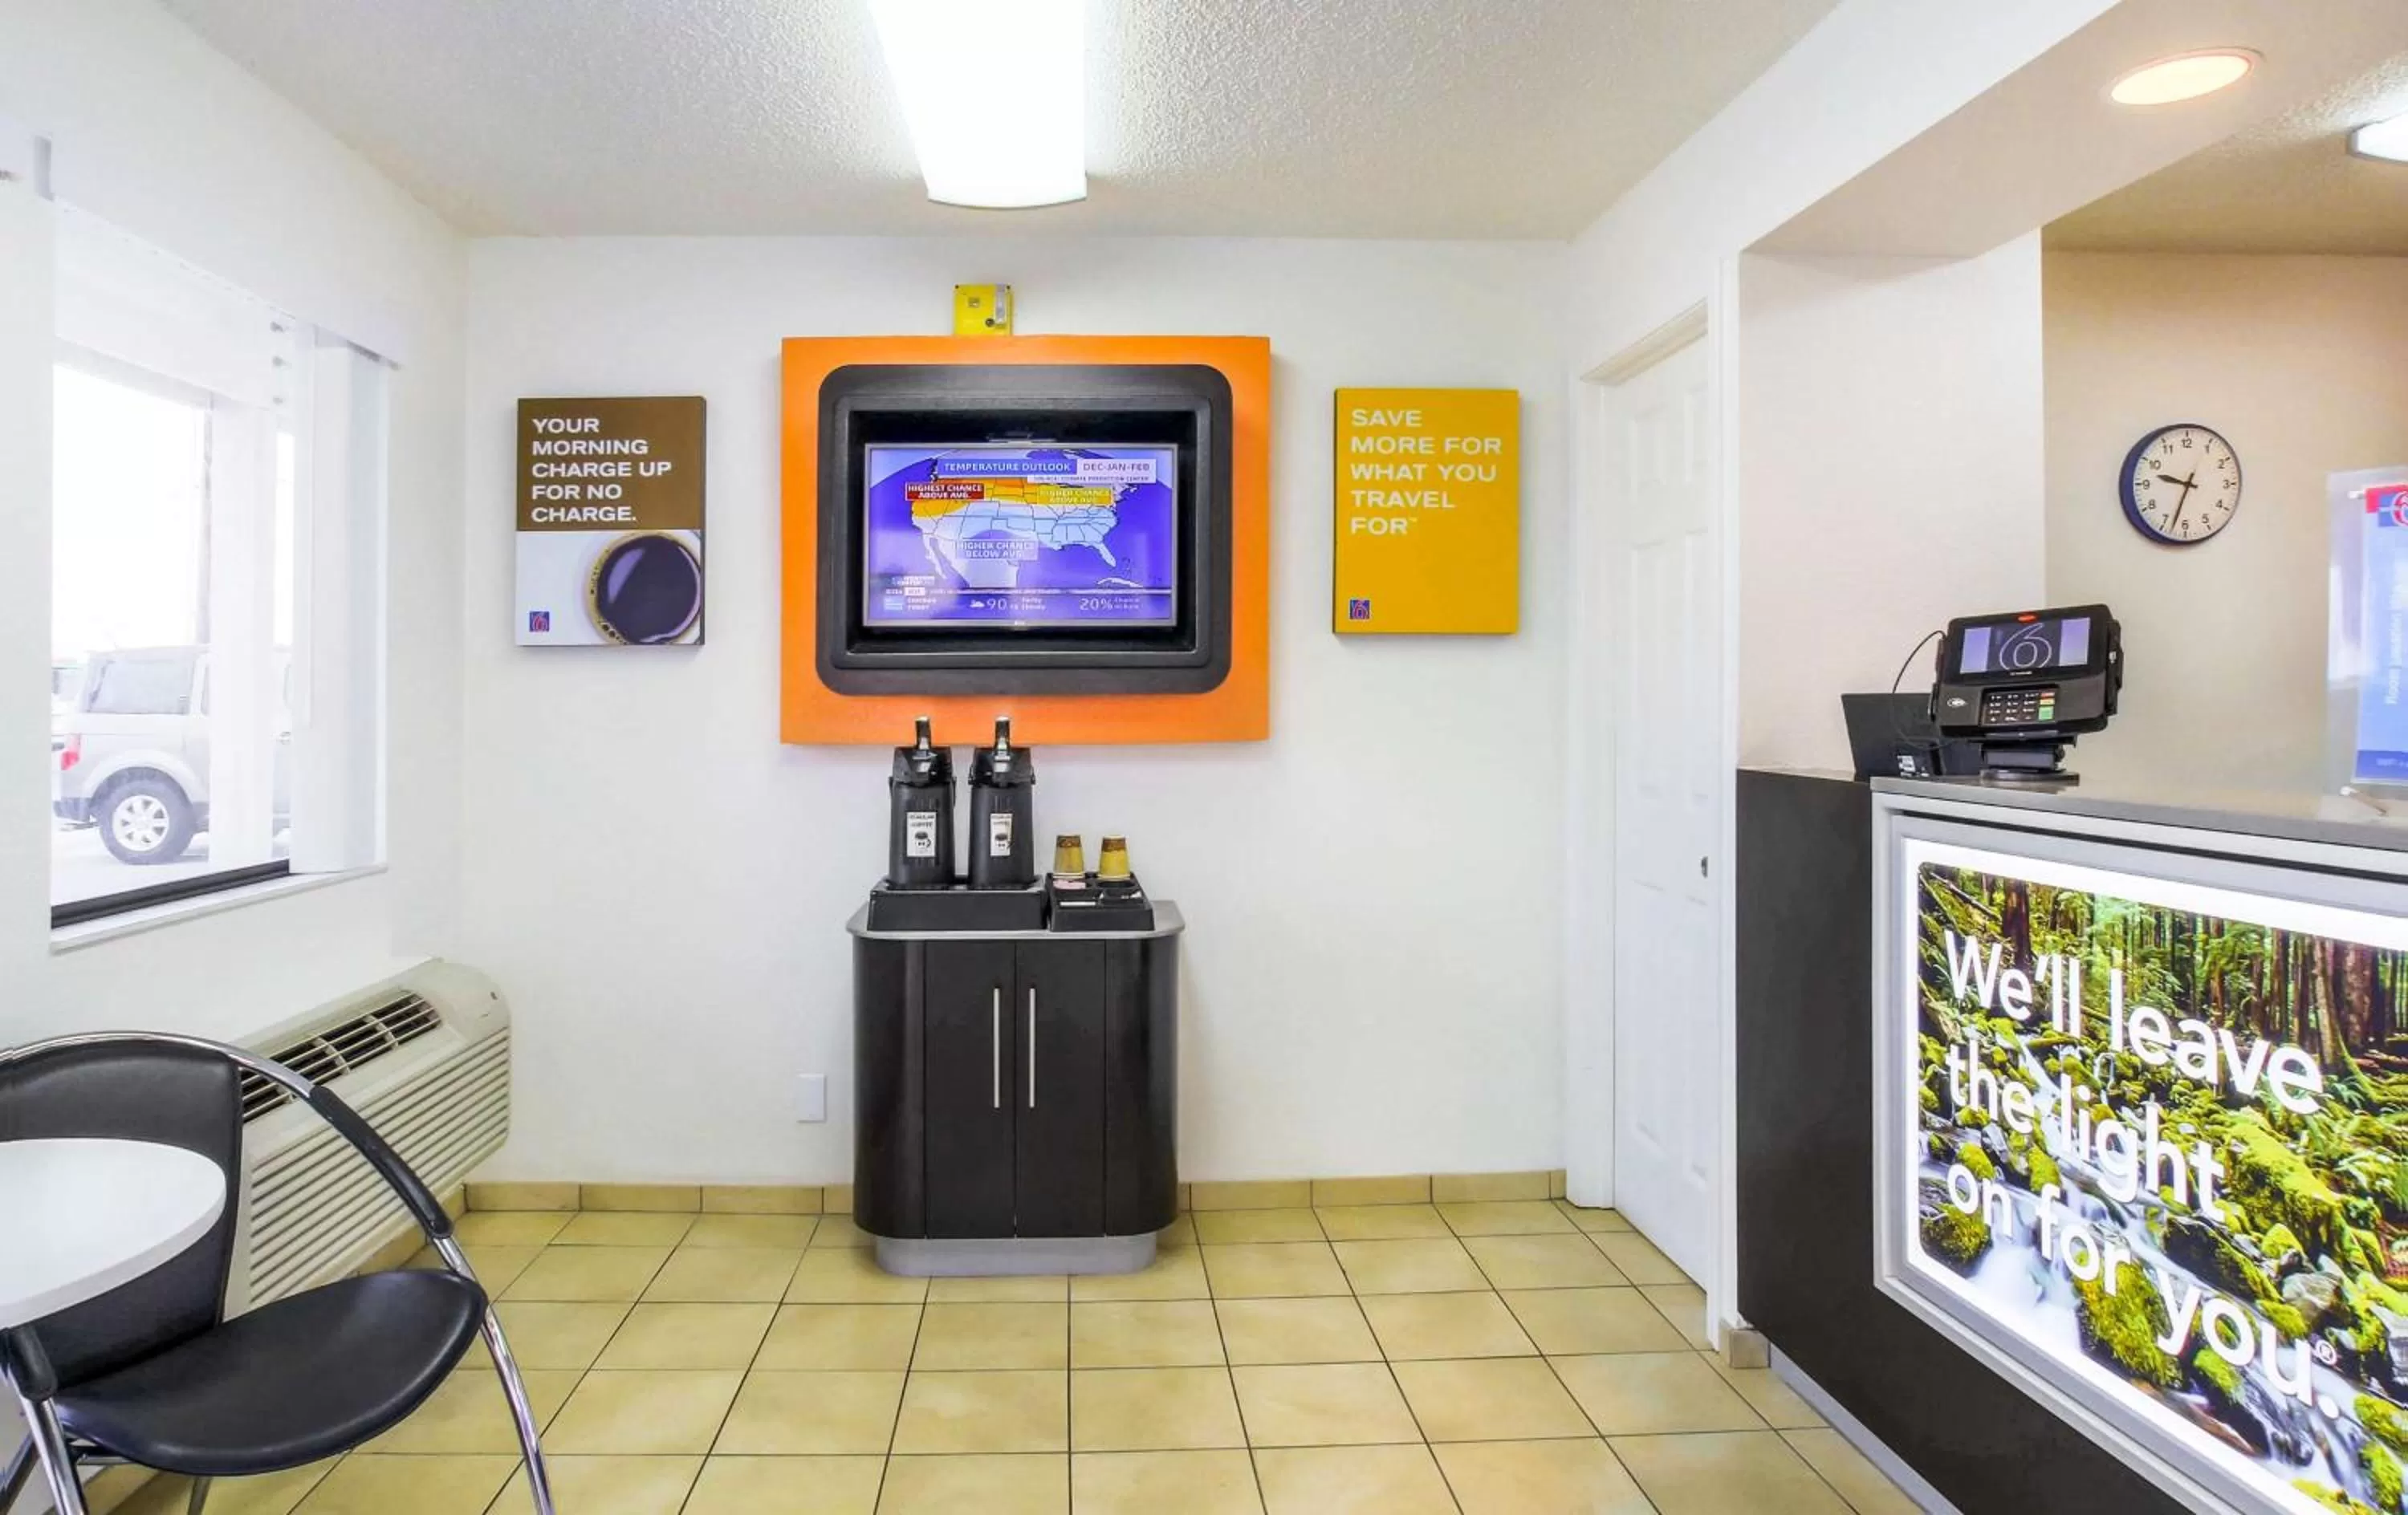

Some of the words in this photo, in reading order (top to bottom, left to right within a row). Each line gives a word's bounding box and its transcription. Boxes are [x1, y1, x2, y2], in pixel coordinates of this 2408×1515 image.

[1351, 409, 1422, 427] SAVE
[532, 418, 600, 433] YOUR
[531, 440, 649, 456] MORNING
[1350, 437, 1436, 454] MORE
[1445, 437, 1502, 454] FOR
[2181, 438, 2192, 449] 12
[2163, 445, 2174, 455] 11
[531, 462, 633, 478] CHARGE
[639, 461, 673, 477] UP
[944, 462, 1019, 472] TEMPERATURE
[1022, 462, 1071, 472] OUTLOOK
[1083, 462, 1150, 472] DEC-JAN-FEB
[2149, 460, 2162, 470] 10
[2217, 459, 2224, 469] 2
[1350, 463, 1429, 481] WHAT
[1438, 464, 1498, 482] YOU
[908, 484, 945, 492] HIGHEST
[946, 484, 982, 492] CHANCE
[2142, 479, 2150, 489] 9
[2222, 479, 2230, 489] 3
[531, 485, 580, 500] FOR
[587, 484, 622, 499] NO
[1350, 489, 1456, 508] TRAVEL
[2147, 498, 2156, 510] 8
[2215, 499, 2223, 509] 4
[531, 506, 637, 522] CHARGE.
[2162, 514, 2170, 524] 7
[2202, 514, 2209, 524] 5
[2181, 520, 2189, 530] 6
[959, 542, 995, 550] HIGHER
[996, 542, 1035, 550] CHANCE
[966, 550, 999, 558] BELOW
[1079, 598, 1113, 610] 20%
[1999, 623, 2052, 671] 6
[1944, 930, 2081, 1038] We'll
[2109, 969, 2323, 1115] leave
[1946, 1040, 2036, 1135] the
[2060, 1073, 2225, 1223] light
[1946, 1163, 2012, 1237] on
[2036, 1183, 2131, 1297] for
